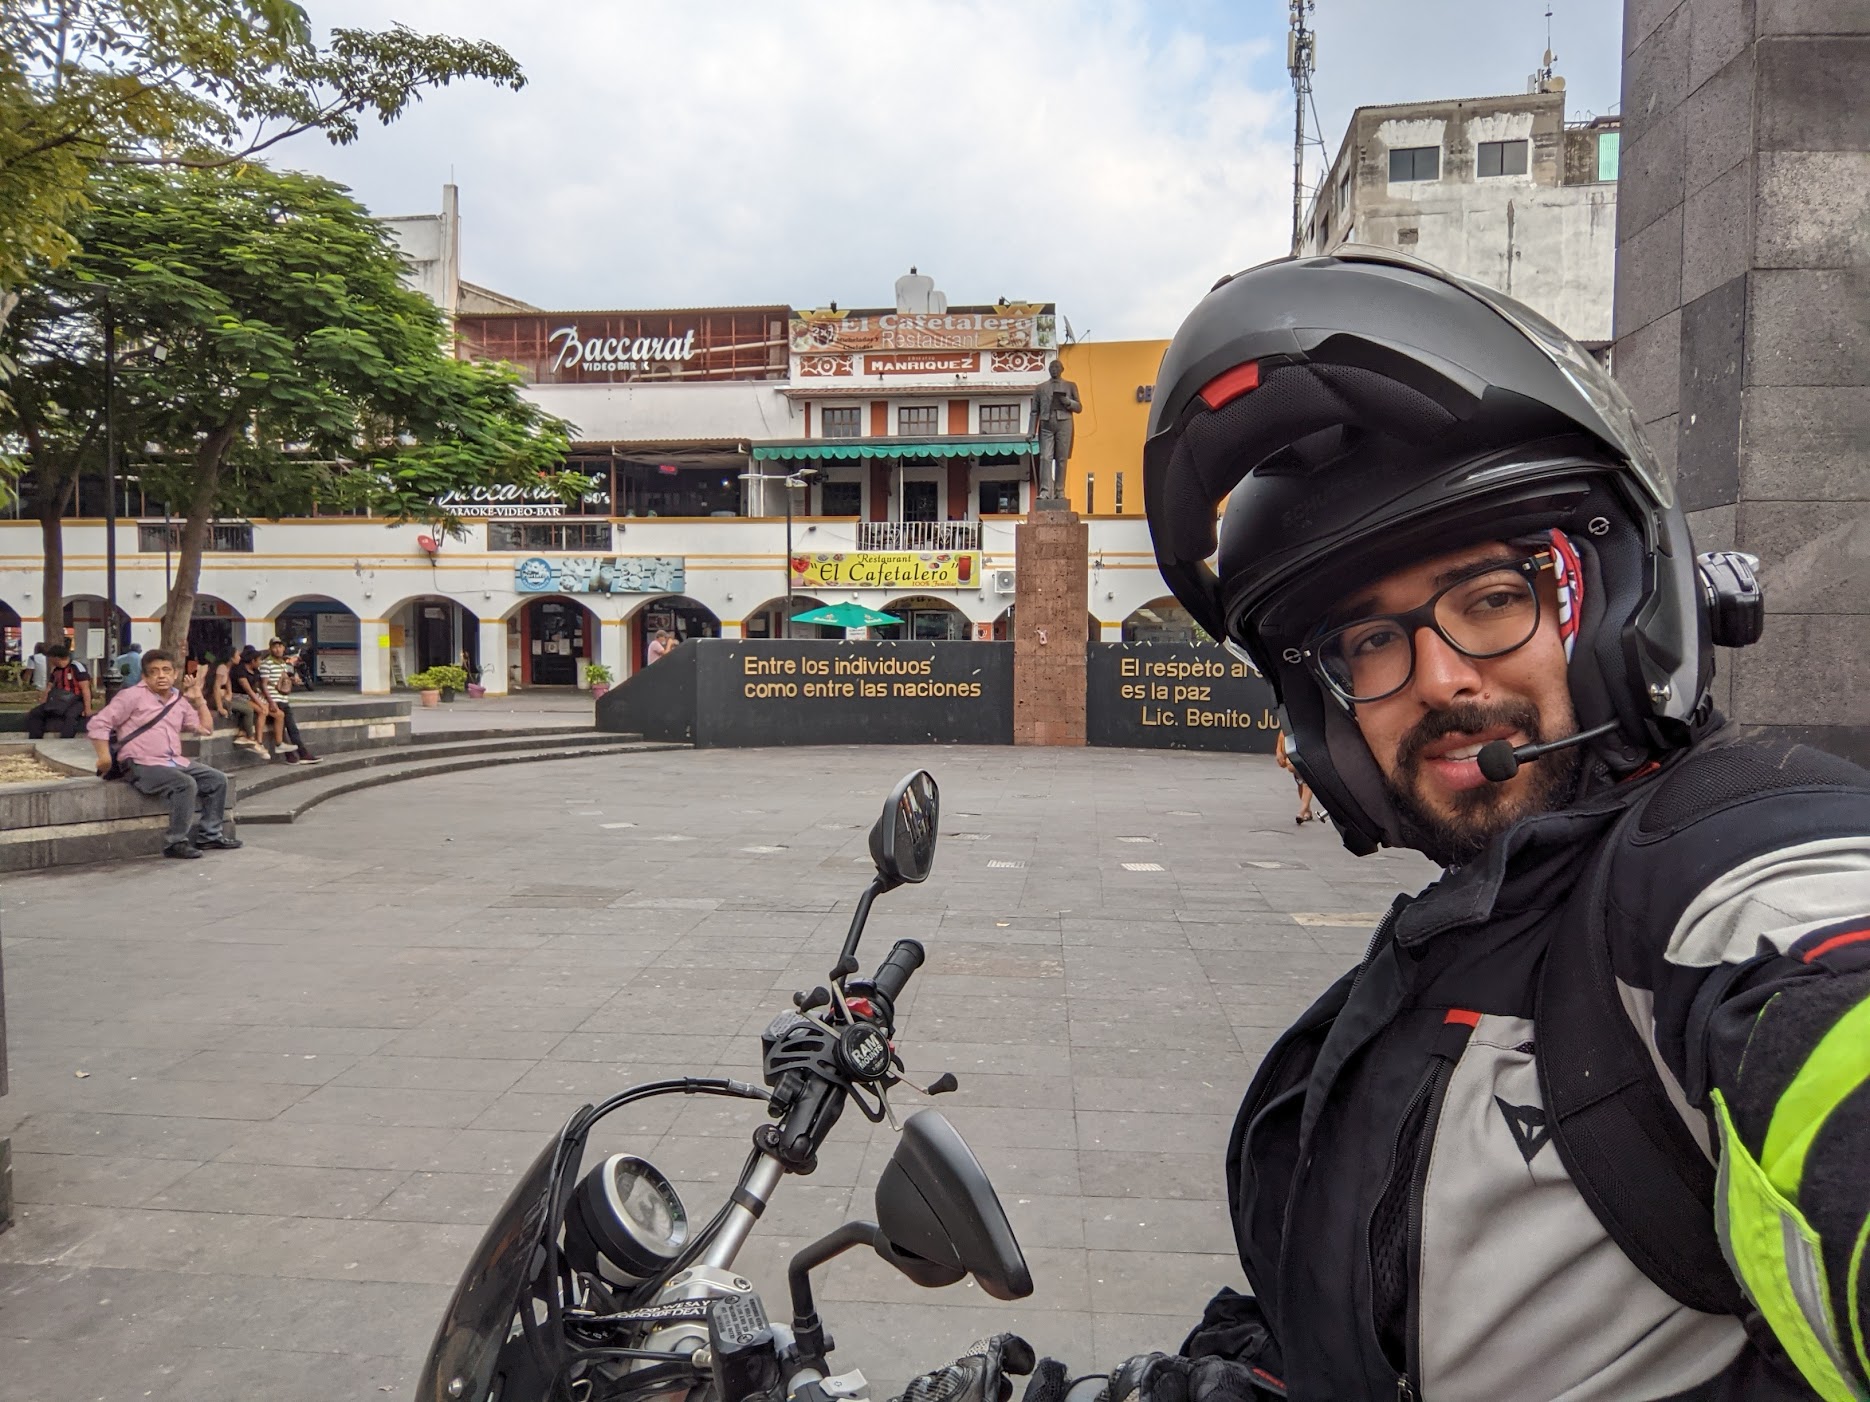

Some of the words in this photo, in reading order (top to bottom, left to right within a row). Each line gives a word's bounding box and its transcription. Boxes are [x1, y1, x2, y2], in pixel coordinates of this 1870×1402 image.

[841, 317, 869, 332] El
[878, 314, 1031, 331] Cafetalero
[549, 326, 695, 372] Baccarat
[881, 331, 980, 349] Restaurant
[582, 362, 616, 371] VIDEO
[617, 361, 637, 370] BAR
[871, 358, 973, 371] MANRIQUEZ
[444, 508, 562, 517] ARAOKE-VIDEO-BAR
[857, 554, 911, 563] Restaurant
[744, 656, 797, 675] Entre
[802, 656, 830, 675] los
[834, 656, 931, 675] individuos
[1121, 658, 1140, 677] El
[1145, 659, 1225, 680] respeto
[1231, 662, 1248, 678] al
[744, 682, 798, 698] como
[803, 681, 855, 697] entre
[860, 679, 888, 697] las
[893, 679, 982, 697] naciones
[1121, 683, 1146, 699] es
[1151, 682, 1169, 700] la
[1174, 685, 1211, 703] paz
[1142, 706, 1179, 726] Lic.
[1186, 708, 1251, 727] Benito
[1257, 709, 1281, 730] Ju
[851, 1033, 880, 1064] RAM
[858, 1045, 884, 1069] MOUNTS
[672, 1305, 707, 1316] DEAT
